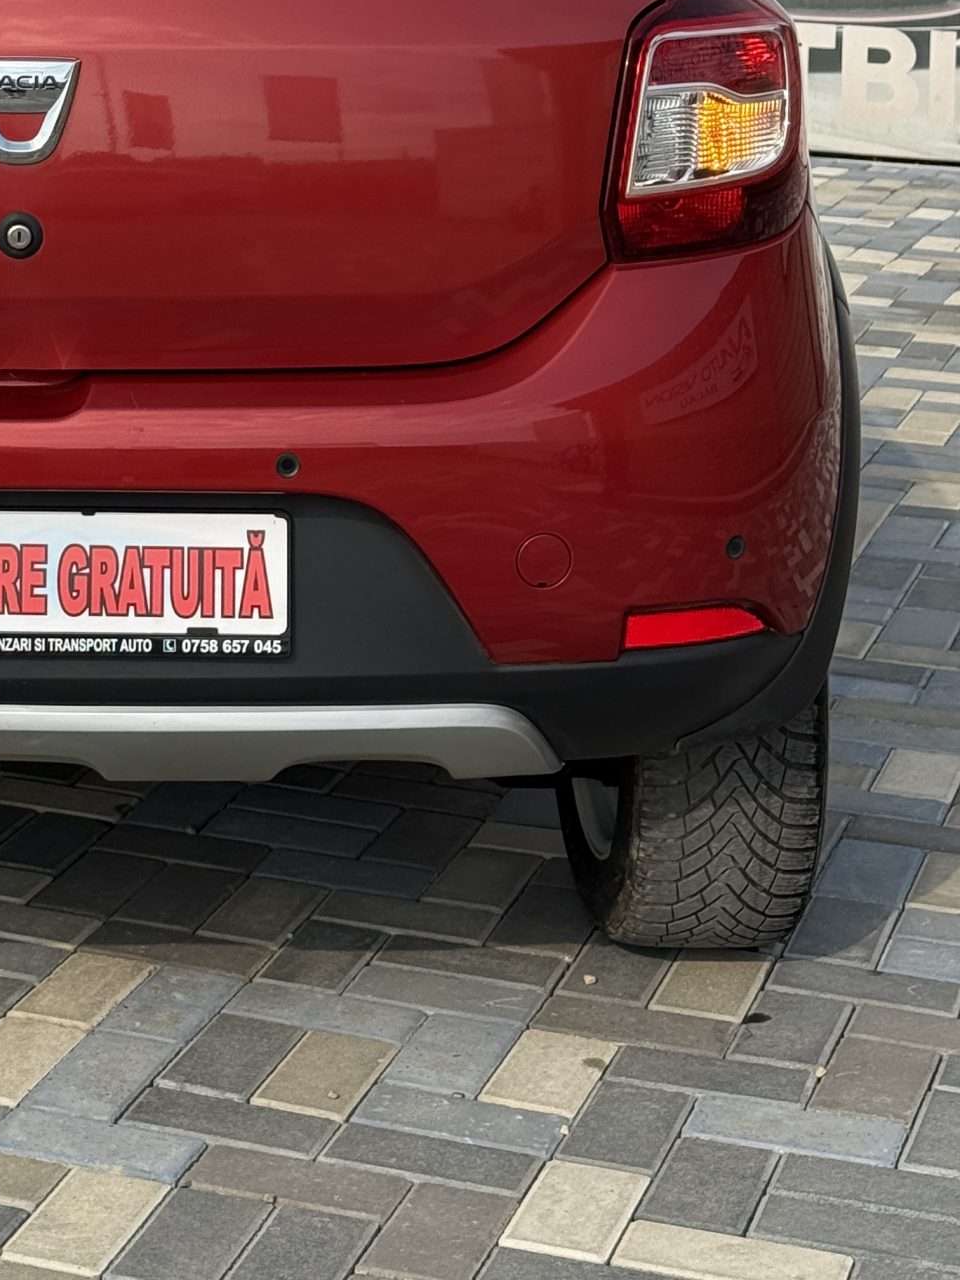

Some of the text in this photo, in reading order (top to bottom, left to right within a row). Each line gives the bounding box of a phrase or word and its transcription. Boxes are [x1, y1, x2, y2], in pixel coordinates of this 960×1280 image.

[57, 529, 274, 619] GRATUITĂ
[34, 638, 46, 652] SI
[47, 638, 118, 652] TRANSPORT
[119, 638, 153, 652] AUTO
[182, 639, 218, 653] 0758
[222, 639, 248, 653] 657
[253, 640, 282, 654] 045
